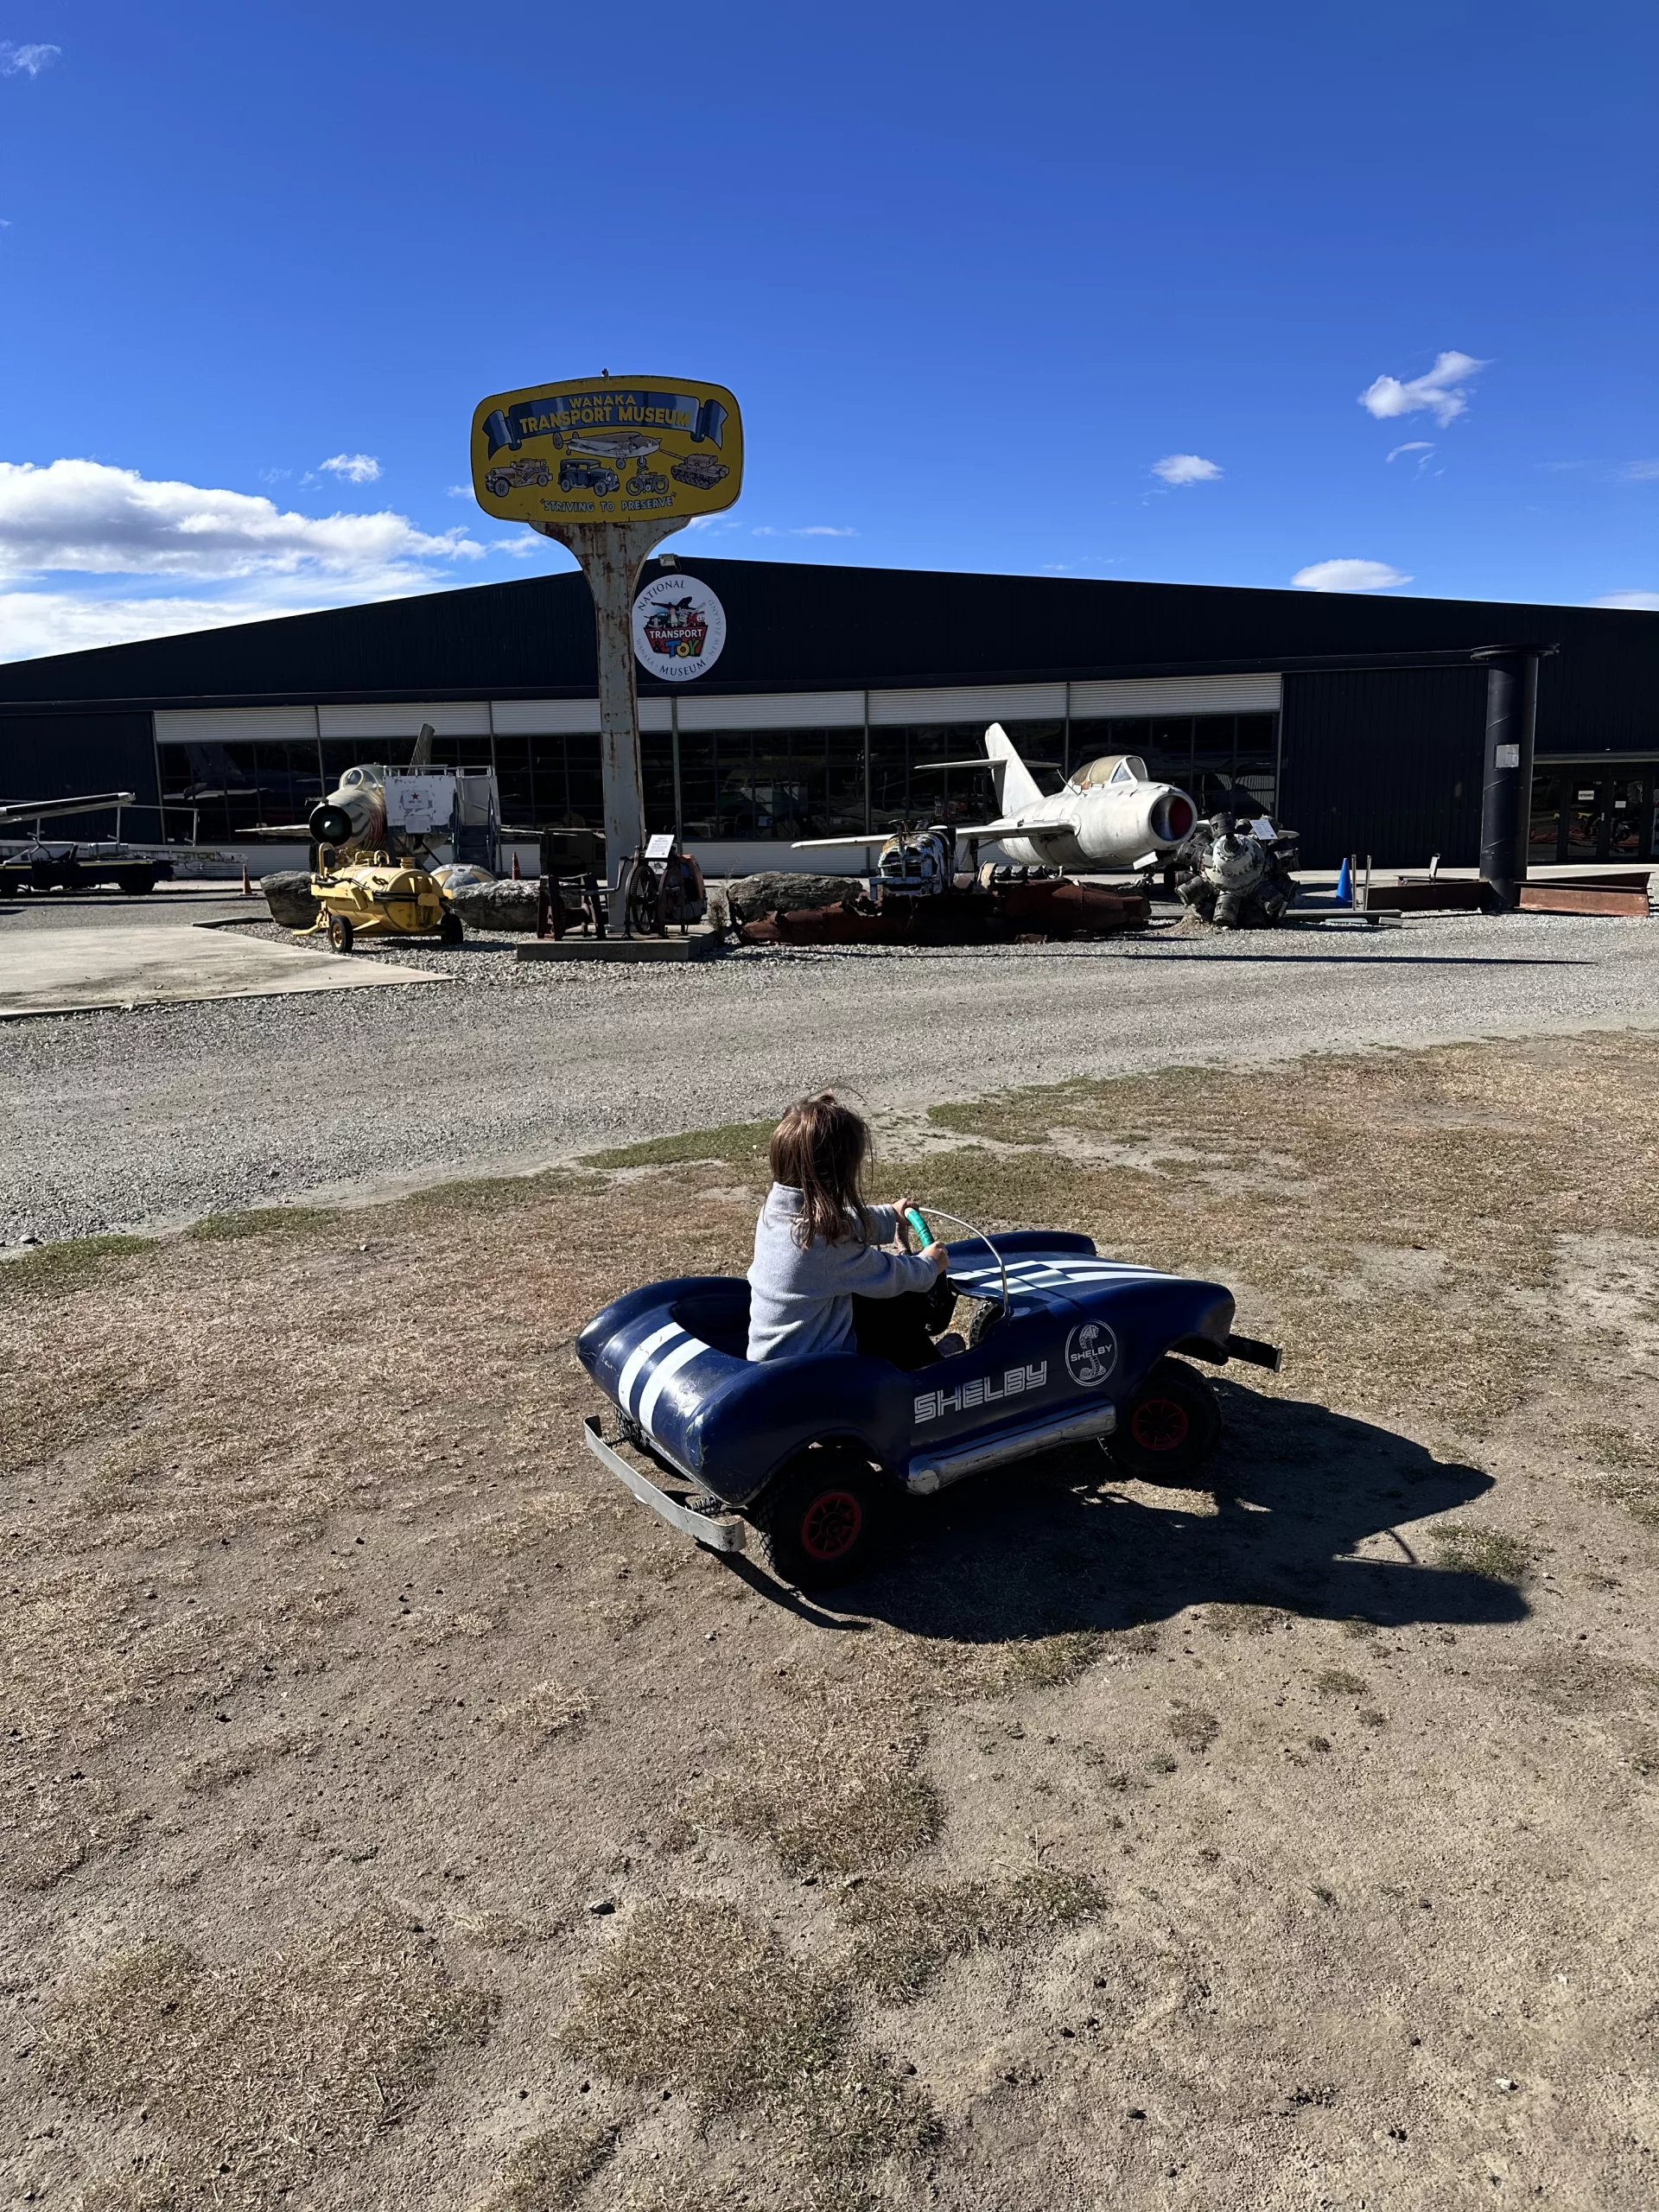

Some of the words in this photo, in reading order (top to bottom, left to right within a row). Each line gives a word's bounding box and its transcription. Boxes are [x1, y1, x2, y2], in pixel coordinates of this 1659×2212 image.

[569, 394, 636, 410] WANAKA
[519, 406, 612, 435] TRANSPORT
[618, 405, 690, 428] MUSEUM
[540, 498, 594, 512] "STRIVING
[601, 501, 615, 512] TO
[621, 492, 677, 512] PRESERVE"
[638, 580, 685, 612] NATIONAL
[708, 599, 721, 636] ZEALAND
[650, 628, 702, 639] TRANSPORT
[636, 638, 654, 666] WANAKA
[653, 640, 662, 652] &
[664, 639, 700, 658] TOY
[709, 638, 720, 657] NEW
[659, 659, 707, 677] MUSEUM
[1071, 1344, 1112, 1363] SHELBY
[914, 1360, 1048, 1424] SHELBY
